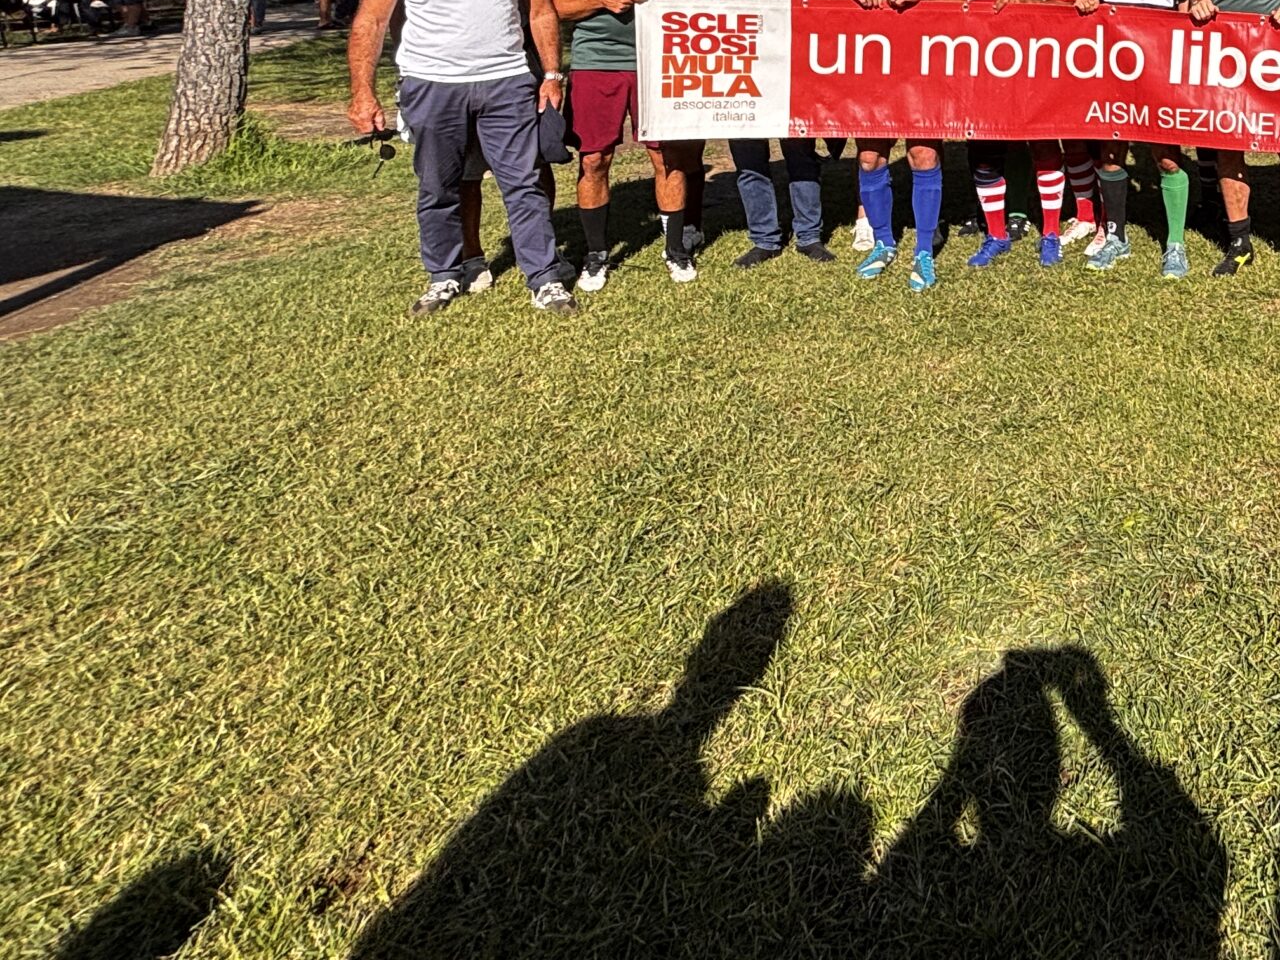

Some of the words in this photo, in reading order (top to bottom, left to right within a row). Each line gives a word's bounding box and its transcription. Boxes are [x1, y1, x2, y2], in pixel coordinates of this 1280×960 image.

[661, 11, 759, 34] SCLE
[808, 33, 892, 76] un
[920, 24, 1146, 82] mondo
[661, 55, 759, 75] MULT
[673, 98, 757, 111] associazione
[712, 110, 756, 123] italiana
[1085, 101, 1150, 127] AISM
[1157, 106, 1274, 137] SEZIONE
